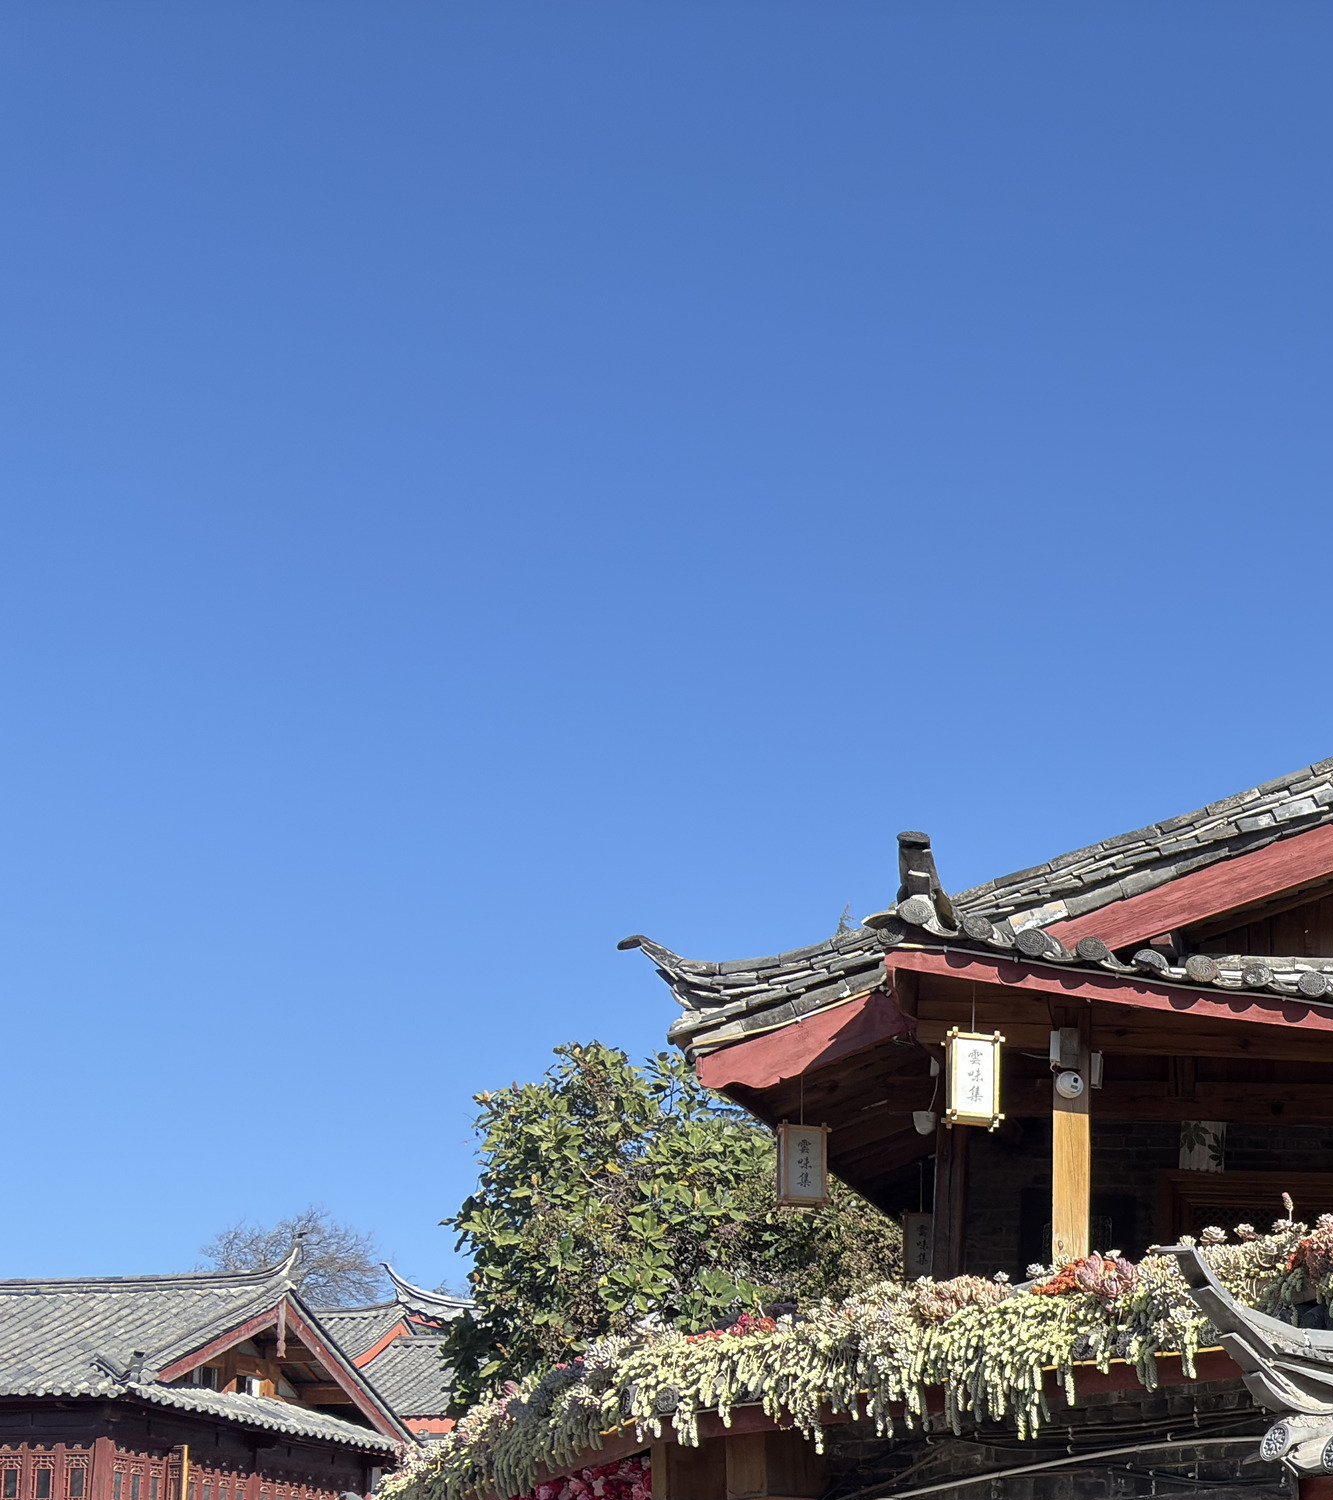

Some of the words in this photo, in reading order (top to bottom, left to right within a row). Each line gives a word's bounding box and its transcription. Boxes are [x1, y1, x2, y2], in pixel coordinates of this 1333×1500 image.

[967, 1049, 983, 1102] 雲味集
[798, 1139, 812, 1188] 雲味集
